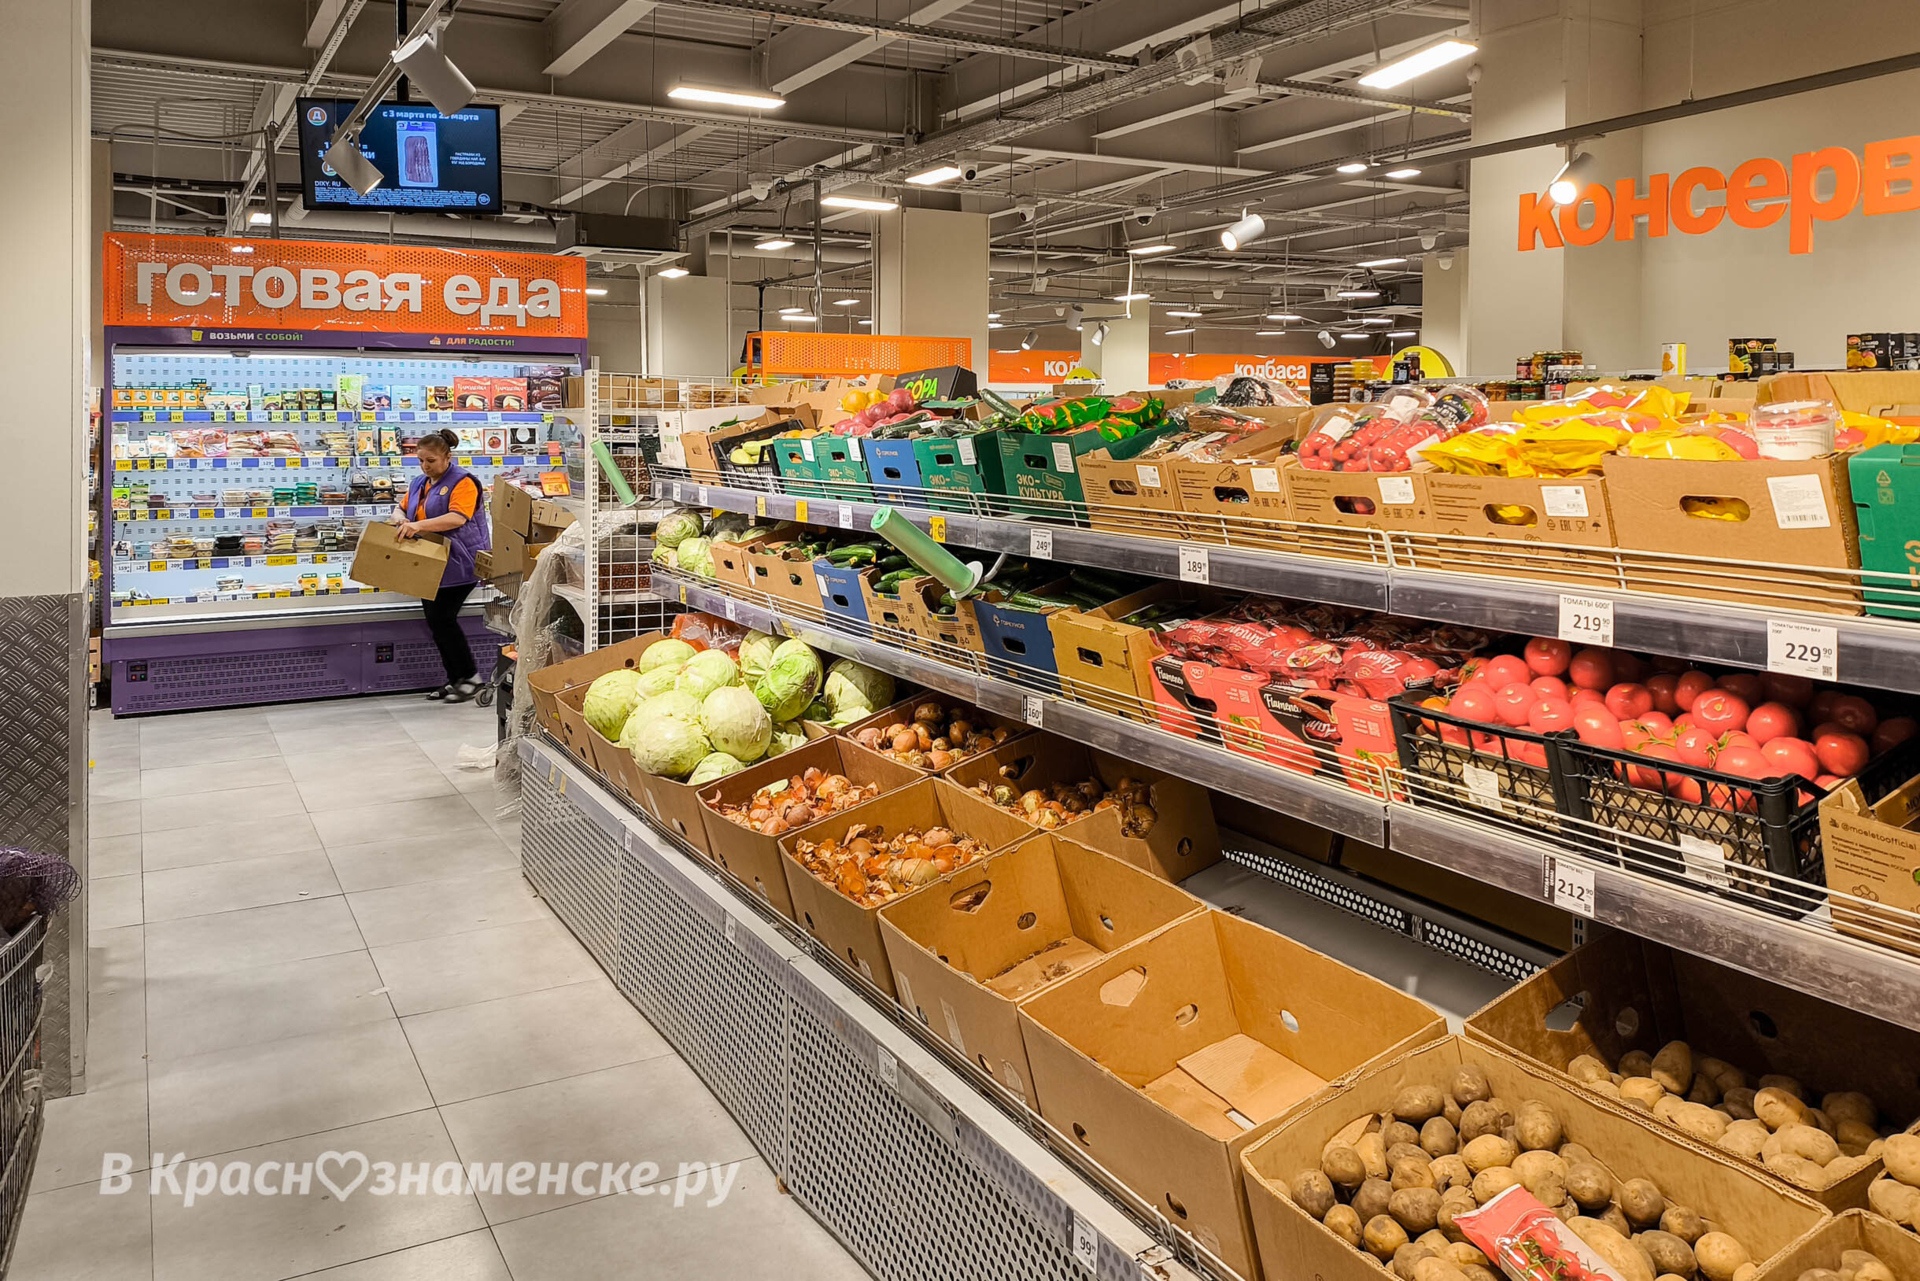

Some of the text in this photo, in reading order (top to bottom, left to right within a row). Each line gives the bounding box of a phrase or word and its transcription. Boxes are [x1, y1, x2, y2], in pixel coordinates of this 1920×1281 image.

[396, 112, 424, 121] марта
[451, 113, 480, 122] марта
[137, 262, 561, 327] готовая еда
[209, 332, 304, 342] ВОЗЬМИ С СОБОЙ!
[446, 337, 515, 347] ДЛЯ РАДОСТИ!
[1234, 358, 1306, 380] колбаса
[929, 474, 950, 485] ЭКО-
[1016, 473, 1040, 484] ЭКО-
[1018, 486, 1064, 501] КУЛЬТУРА
[1036, 540, 1048, 551] 249
[1187, 561, 1202, 573] 189
[1563, 597, 1594, 607] ТОМАТЫ
[1573, 614, 1601, 632] 219
[1785, 642, 1821, 663] 229
[1028, 708, 1039, 719] 160
[1841, 822, 1917, 851] @moeletoofficial
[1558, 879, 1594, 902] 212 90
[1080, 1236, 1091, 1256] 99
